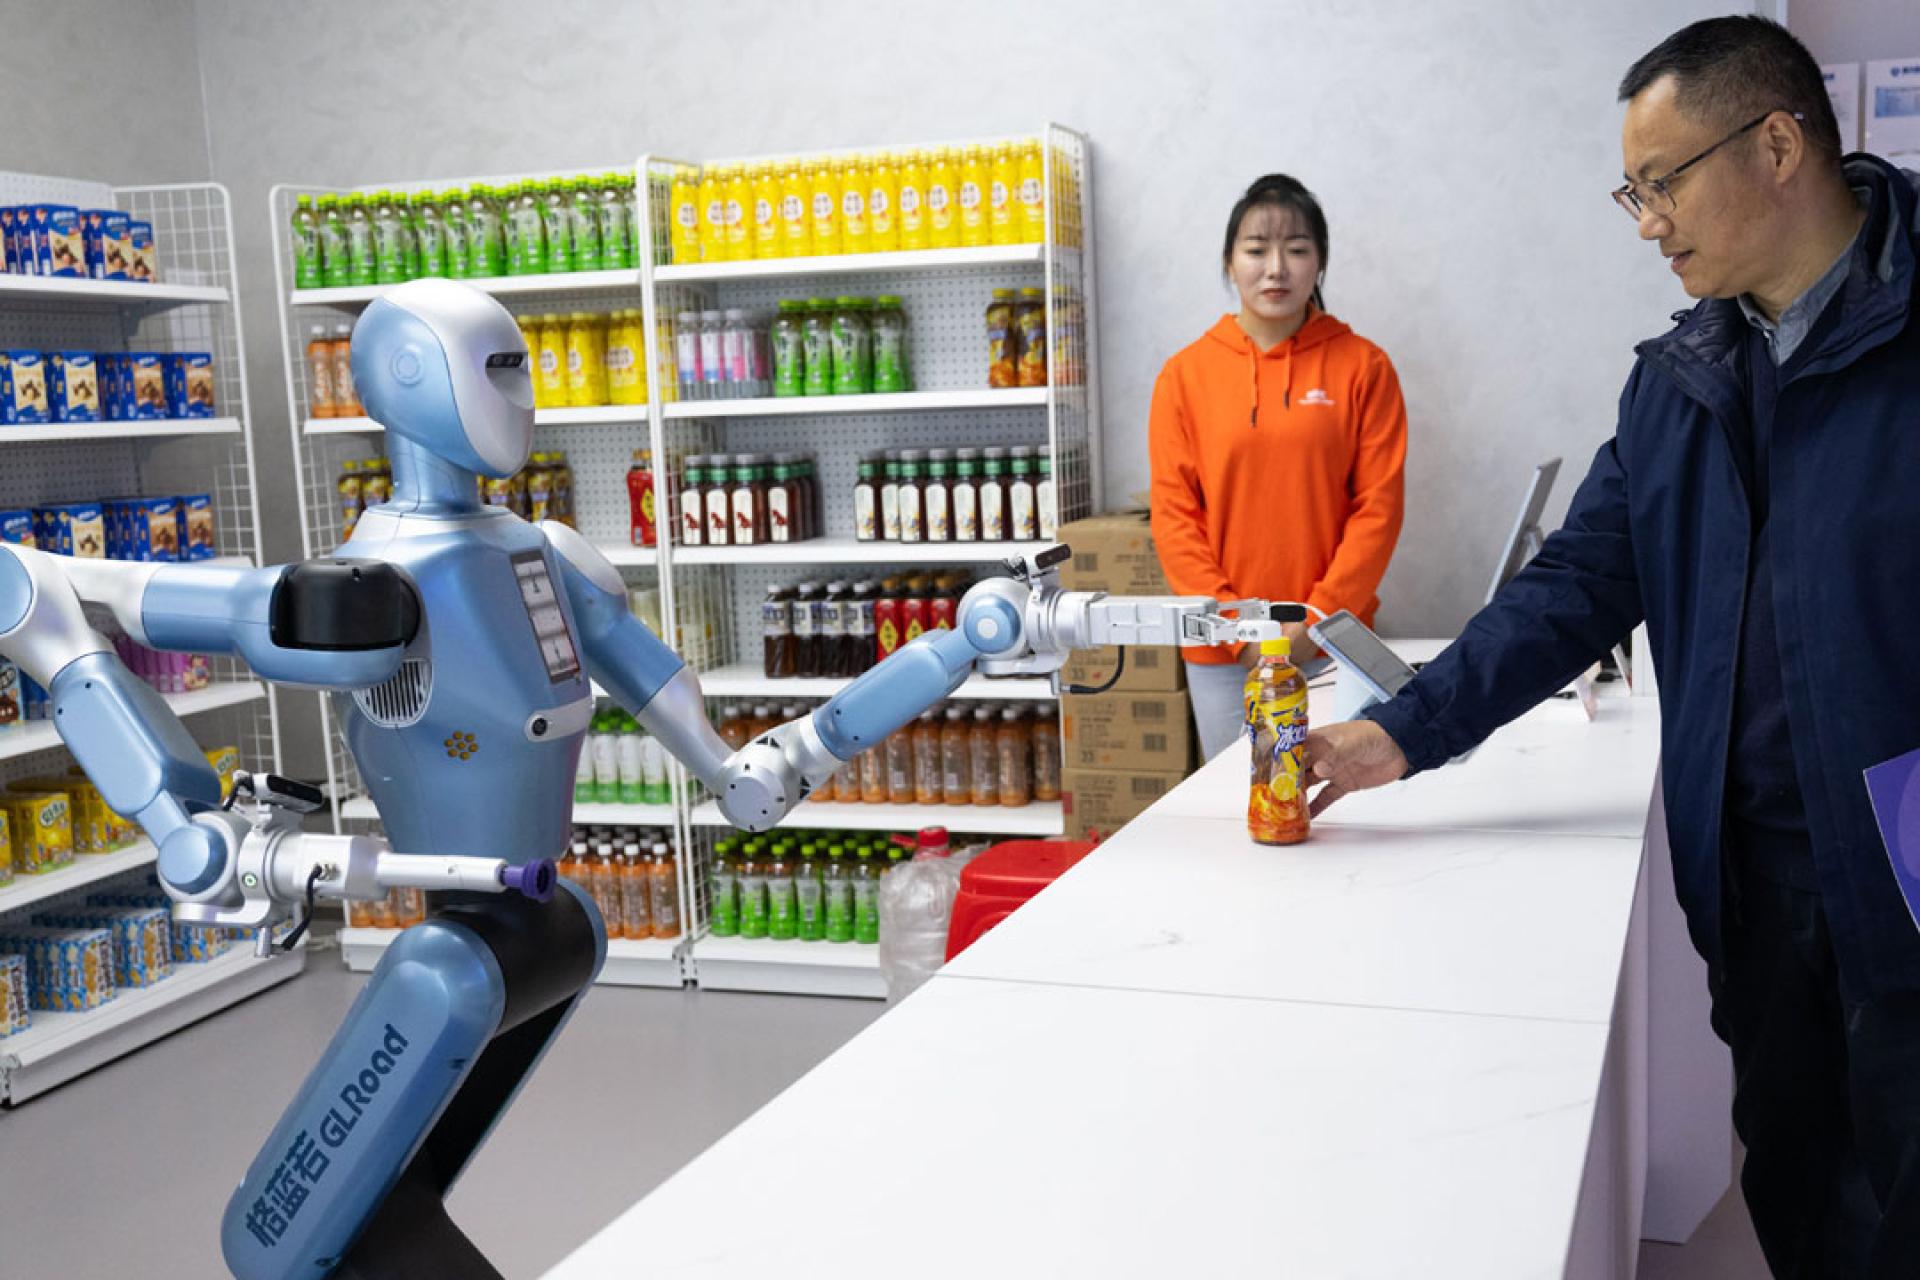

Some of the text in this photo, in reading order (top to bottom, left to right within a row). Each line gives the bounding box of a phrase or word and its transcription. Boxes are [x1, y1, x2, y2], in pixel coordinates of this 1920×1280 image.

[246, 1023, 409, 1248] 格蓝若 GLRoad
